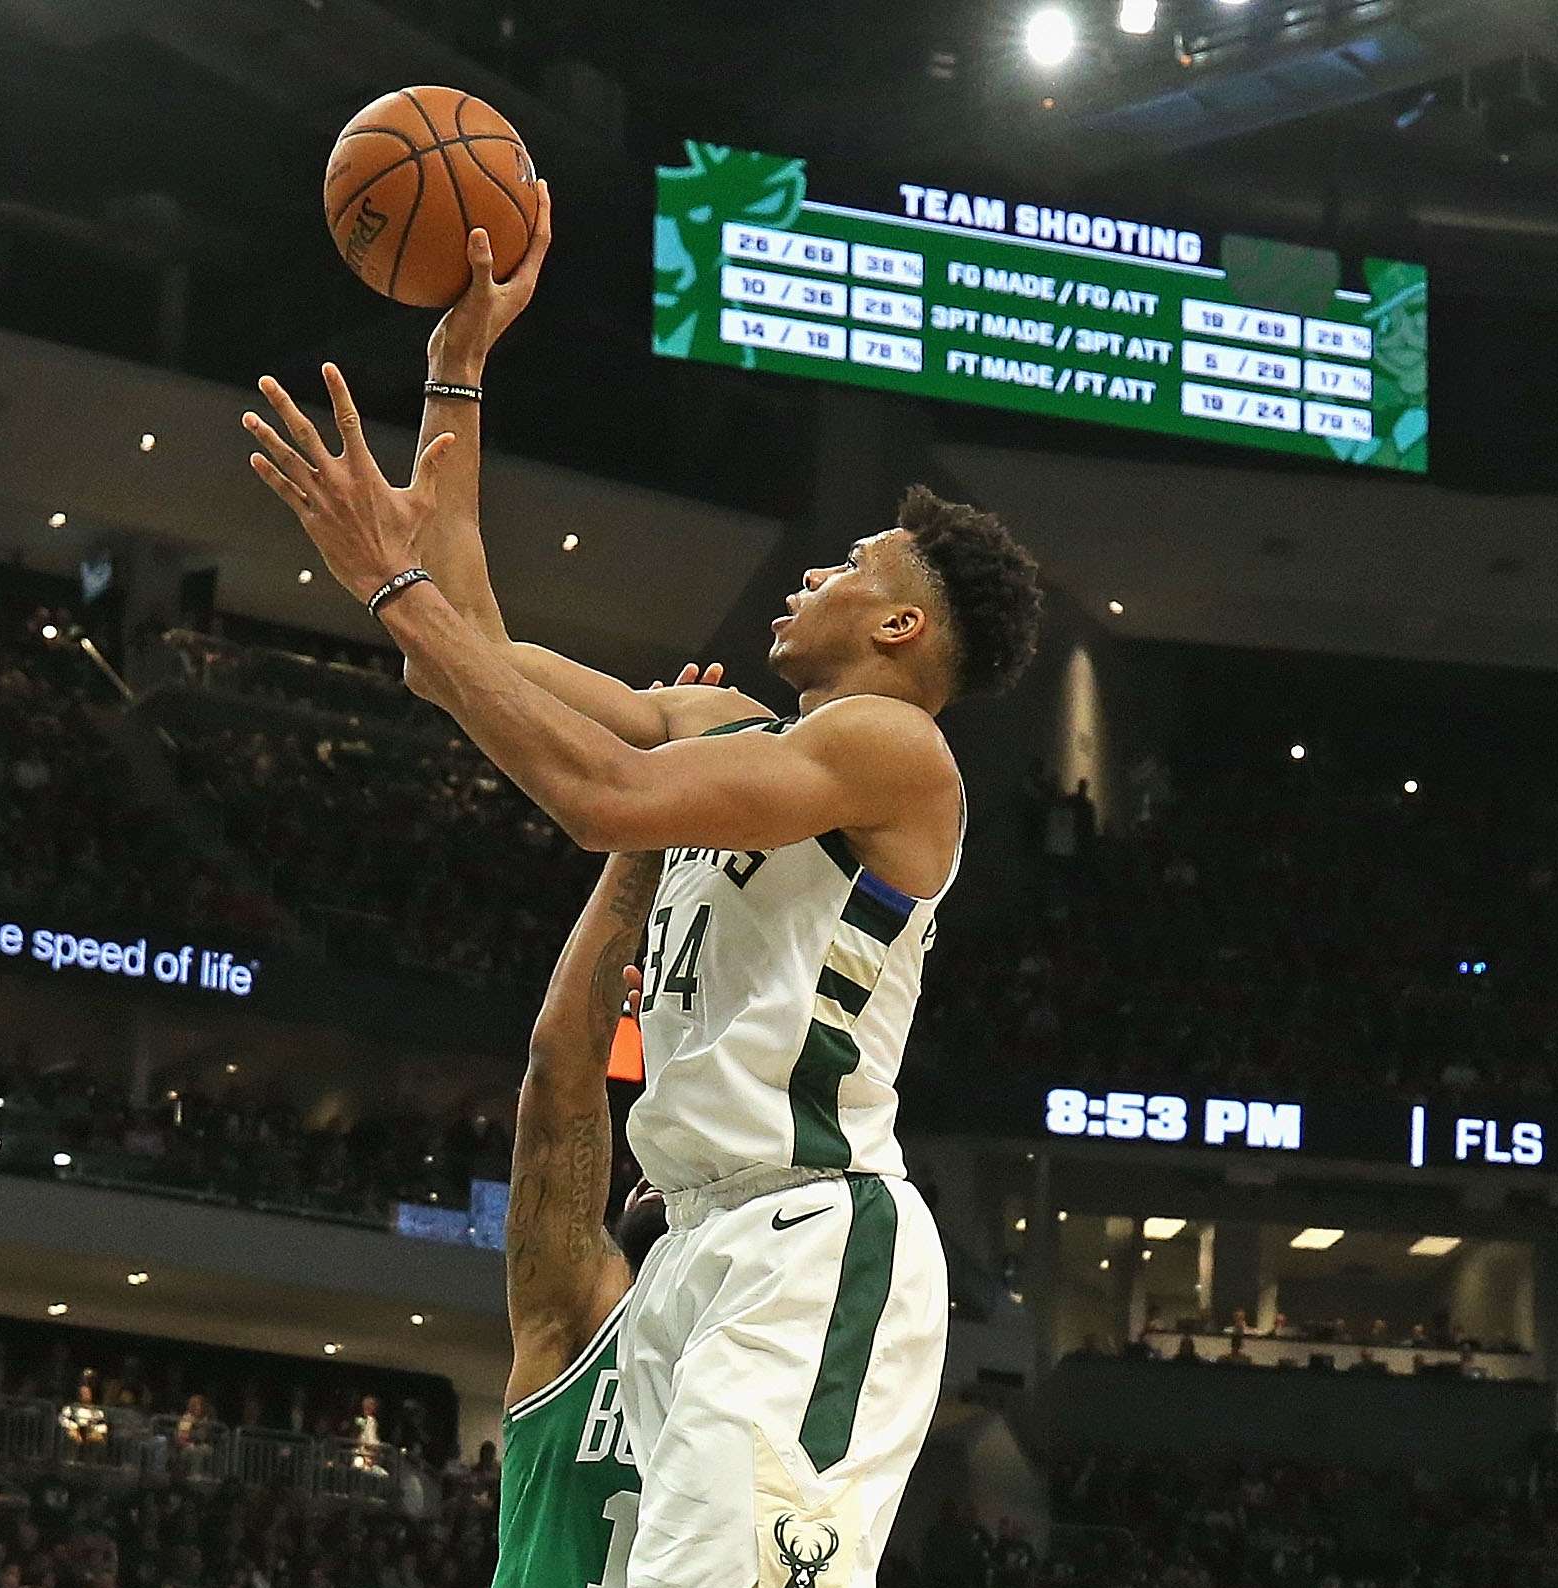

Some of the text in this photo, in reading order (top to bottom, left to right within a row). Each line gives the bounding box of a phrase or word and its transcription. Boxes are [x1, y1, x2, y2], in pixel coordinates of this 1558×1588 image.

[900, 184, 1202, 264] TEAM SHOOTING
[742, 277, 766, 295] 10
[983, 267, 1056, 301] MADE
[1112, 289, 1160, 317] ATT
[742, 320, 765, 337] 14
[931, 305, 980, 333] 3PT
[982, 314, 1055, 347] MADE
[1075, 329, 1125, 357] 3PT
[1125, 338, 1174, 365] ATT
[947, 350, 980, 377] FT
[981, 356, 1055, 390] MADE
[1074, 370, 1108, 397] FT
[1108, 377, 1157, 404] ATT
[1320, 371, 1340, 387] 17
[32, 928, 146, 977] speed
[154, 944, 194, 985] of
[200, 950, 252, 996] life
[642, 904, 712, 1013] 34
[1046, 1089, 1302, 1151] 8:53 PM
[1455, 1118, 1544, 1165] FLS
